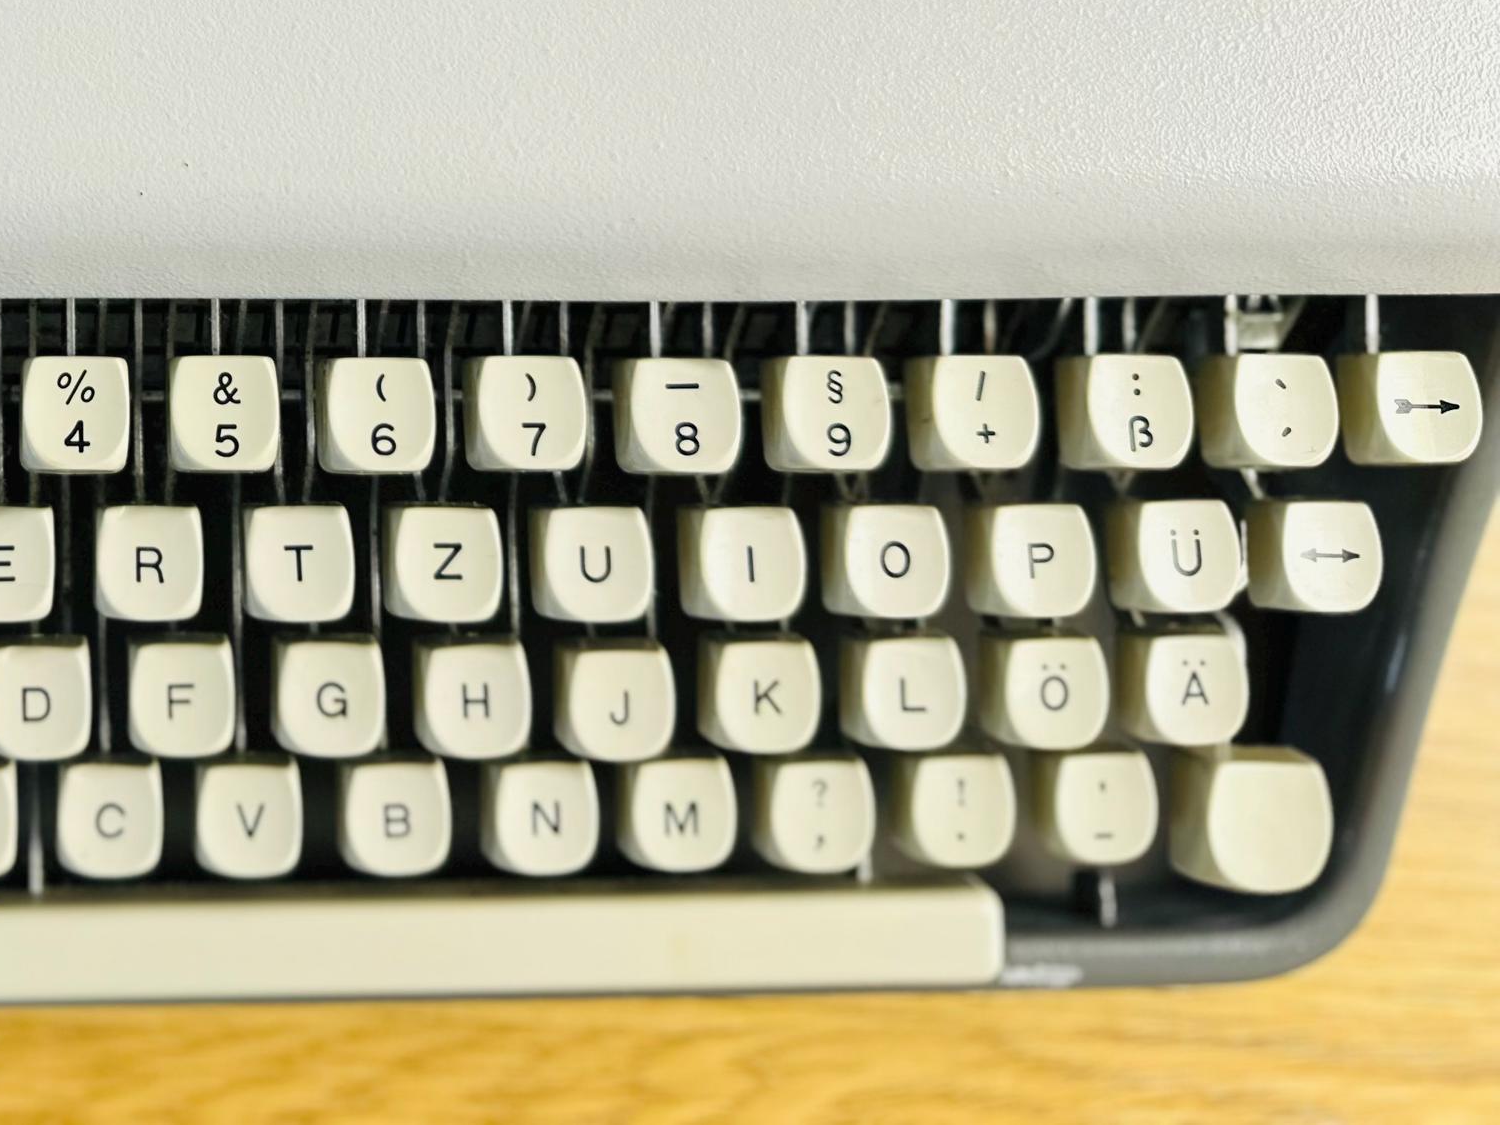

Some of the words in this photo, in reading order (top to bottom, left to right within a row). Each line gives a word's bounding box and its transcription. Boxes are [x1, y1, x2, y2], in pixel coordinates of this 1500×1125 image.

[56, 369, 96, 406] %
[212, 371, 242, 406] &
[375, 373, 387, 402] (
[525, 373, 537, 402] )
[827, 369, 844, 405] §
[975, 370, 987, 402] /
[1132, 373, 1142, 397] :
[63, 419, 91, 454] 4
[215, 423, 240, 458] 5
[370, 422, 397, 457] 6
[521, 422, 547, 457] 7
[675, 421, 701, 457] 8
[827, 422, 852, 457] 9
[977, 423, 997, 444] +
[135, 546, 165, 584] R
[283, 544, 314, 582] T
[433, 542, 463, 581] Z
[579, 545, 612, 584] U
[880, 541, 912, 579] O
[1029, 542, 1055, 578] P
[1169, 528, 1204, 578] Ü
[167, 683, 195, 719] F
[316, 682, 348, 718] G
[462, 683, 490, 718] H
[753, 679, 782, 716] K
[899, 678, 927, 713] L
[1039, 664, 1070, 712] Ö
[1181, 660, 1210, 707] Ä
[21, 686, 52, 723] D
[609, 690, 631, 727] J
[94, 801, 126, 840] C
[238, 805, 264, 839] V
[383, 803, 412, 839] B
[531, 800, 562, 837] N
[664, 800, 699, 835] M
